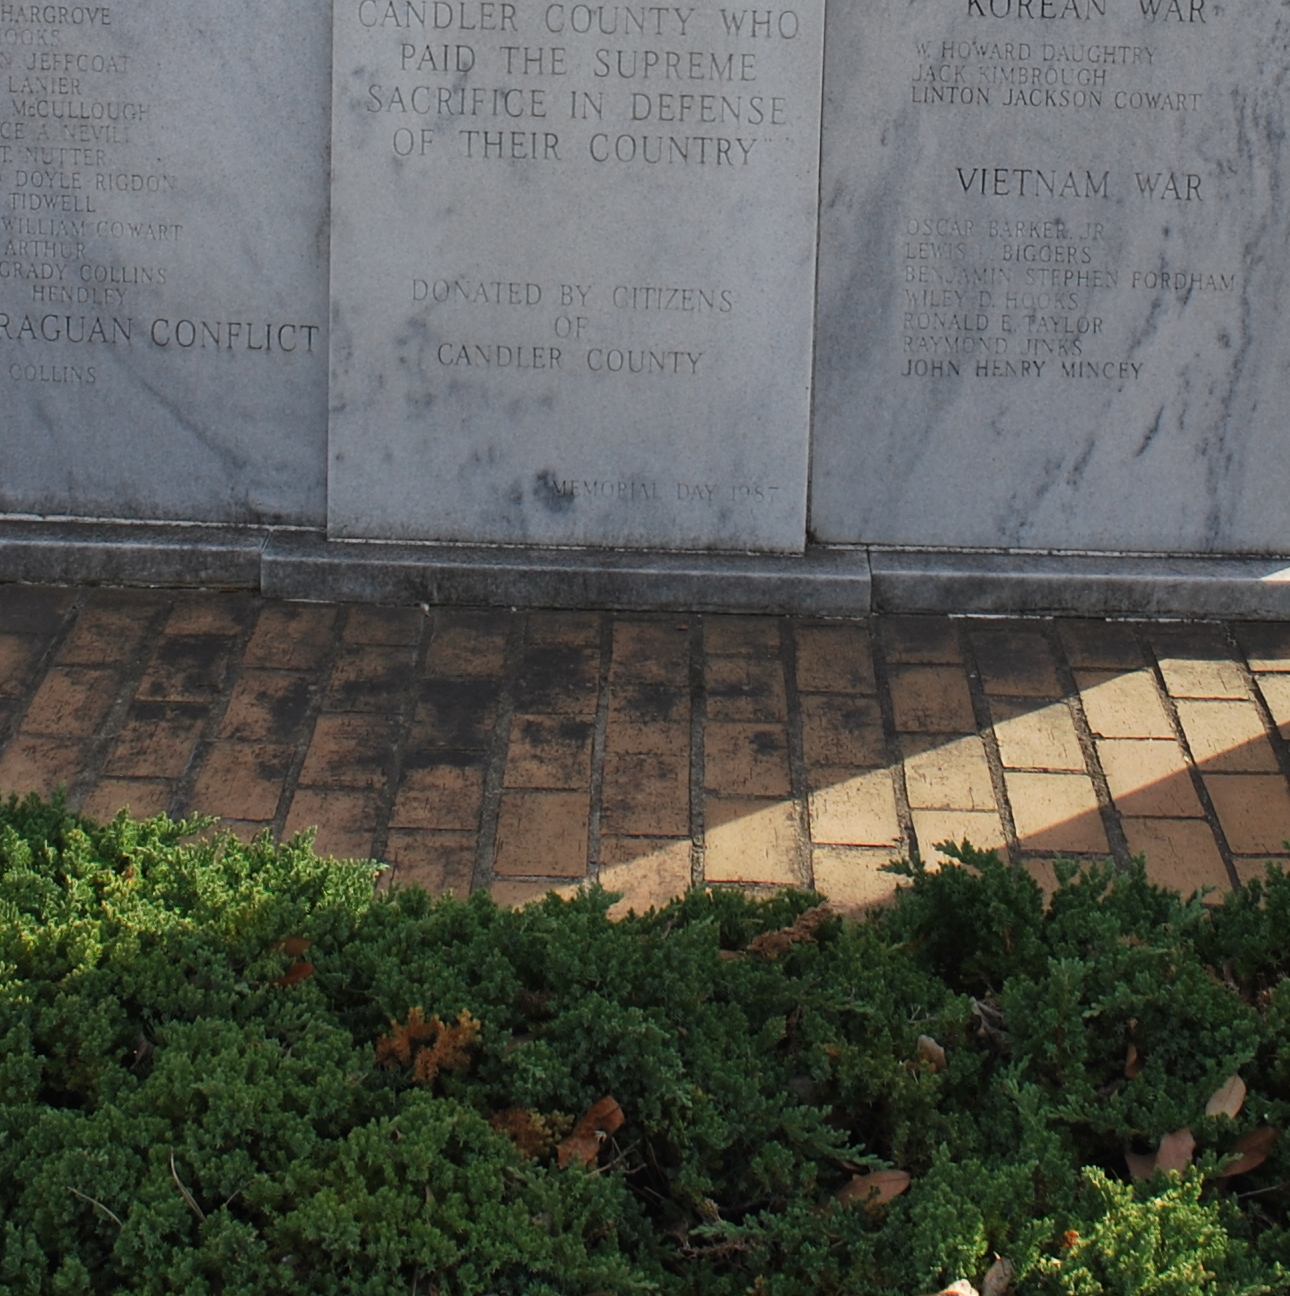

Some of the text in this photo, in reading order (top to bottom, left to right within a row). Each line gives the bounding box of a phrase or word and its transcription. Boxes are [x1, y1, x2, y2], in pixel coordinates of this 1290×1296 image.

[1, 4, 111, 26] HARGROVE
[357, 0, 799, 40] CANDLER COUNTY WHO
[27, 53, 132, 73] JEFFCOAT
[400, 44, 758, 82] PAID THE SUPREME
[941, 43, 1157, 65] HOWARD DAUGHTRY
[8, 77, 82, 95] LANIER
[912, 64, 1107, 87] JACK KIMBROUGH
[366, 85, 787, 125] SACRIFICE IN DEFENSE
[911, 86, 1202, 111] LINTON JACKSON COWART
[13, 99, 151, 122] McCULLOUGH
[24, 146, 106, 167] NUTTER
[393, 127, 758, 166] OF THEIR COUNTRY
[16, 170, 81, 189] DOYLE
[95, 172, 178, 192] RIGDON
[956, 167, 1203, 202] VIETNAM WAR
[8, 192, 96, 213] TIDWELL
[1, 216, 85, 236] WILLIAM
[97, 221, 184, 242] COWART
[907, 218, 974, 238] OSCAR
[4, 239, 86, 259] ARTHUR
[906, 242, 965, 262] LEWIS
[1003, 245, 1092, 264] BIGGERS
[79, 264, 167, 285] COLLINS
[905, 265, 1235, 291] BENJAMIN STEPHEN FORDHAM
[33, 285, 128, 305] HENDLEY
[411, 278, 734, 313] DONATED BY CITIZENS
[905, 289, 965, 308] WILEY
[1005, 292, 1079, 310] HOOKS
[554, 316, 589, 339] OF
[903, 313, 1103, 334] RONALD E. TAYLOR
[150, 318, 319, 353] CONFLICT
[903, 336, 1083, 356] RAYMOND JINKS
[437, 343, 703, 375] CANDLER COUNTY
[902, 359, 1145, 380] JOHN HENRY MINCEY
[9, 363, 97, 384] COLLINS
[677, 483, 715, 503] DAY
